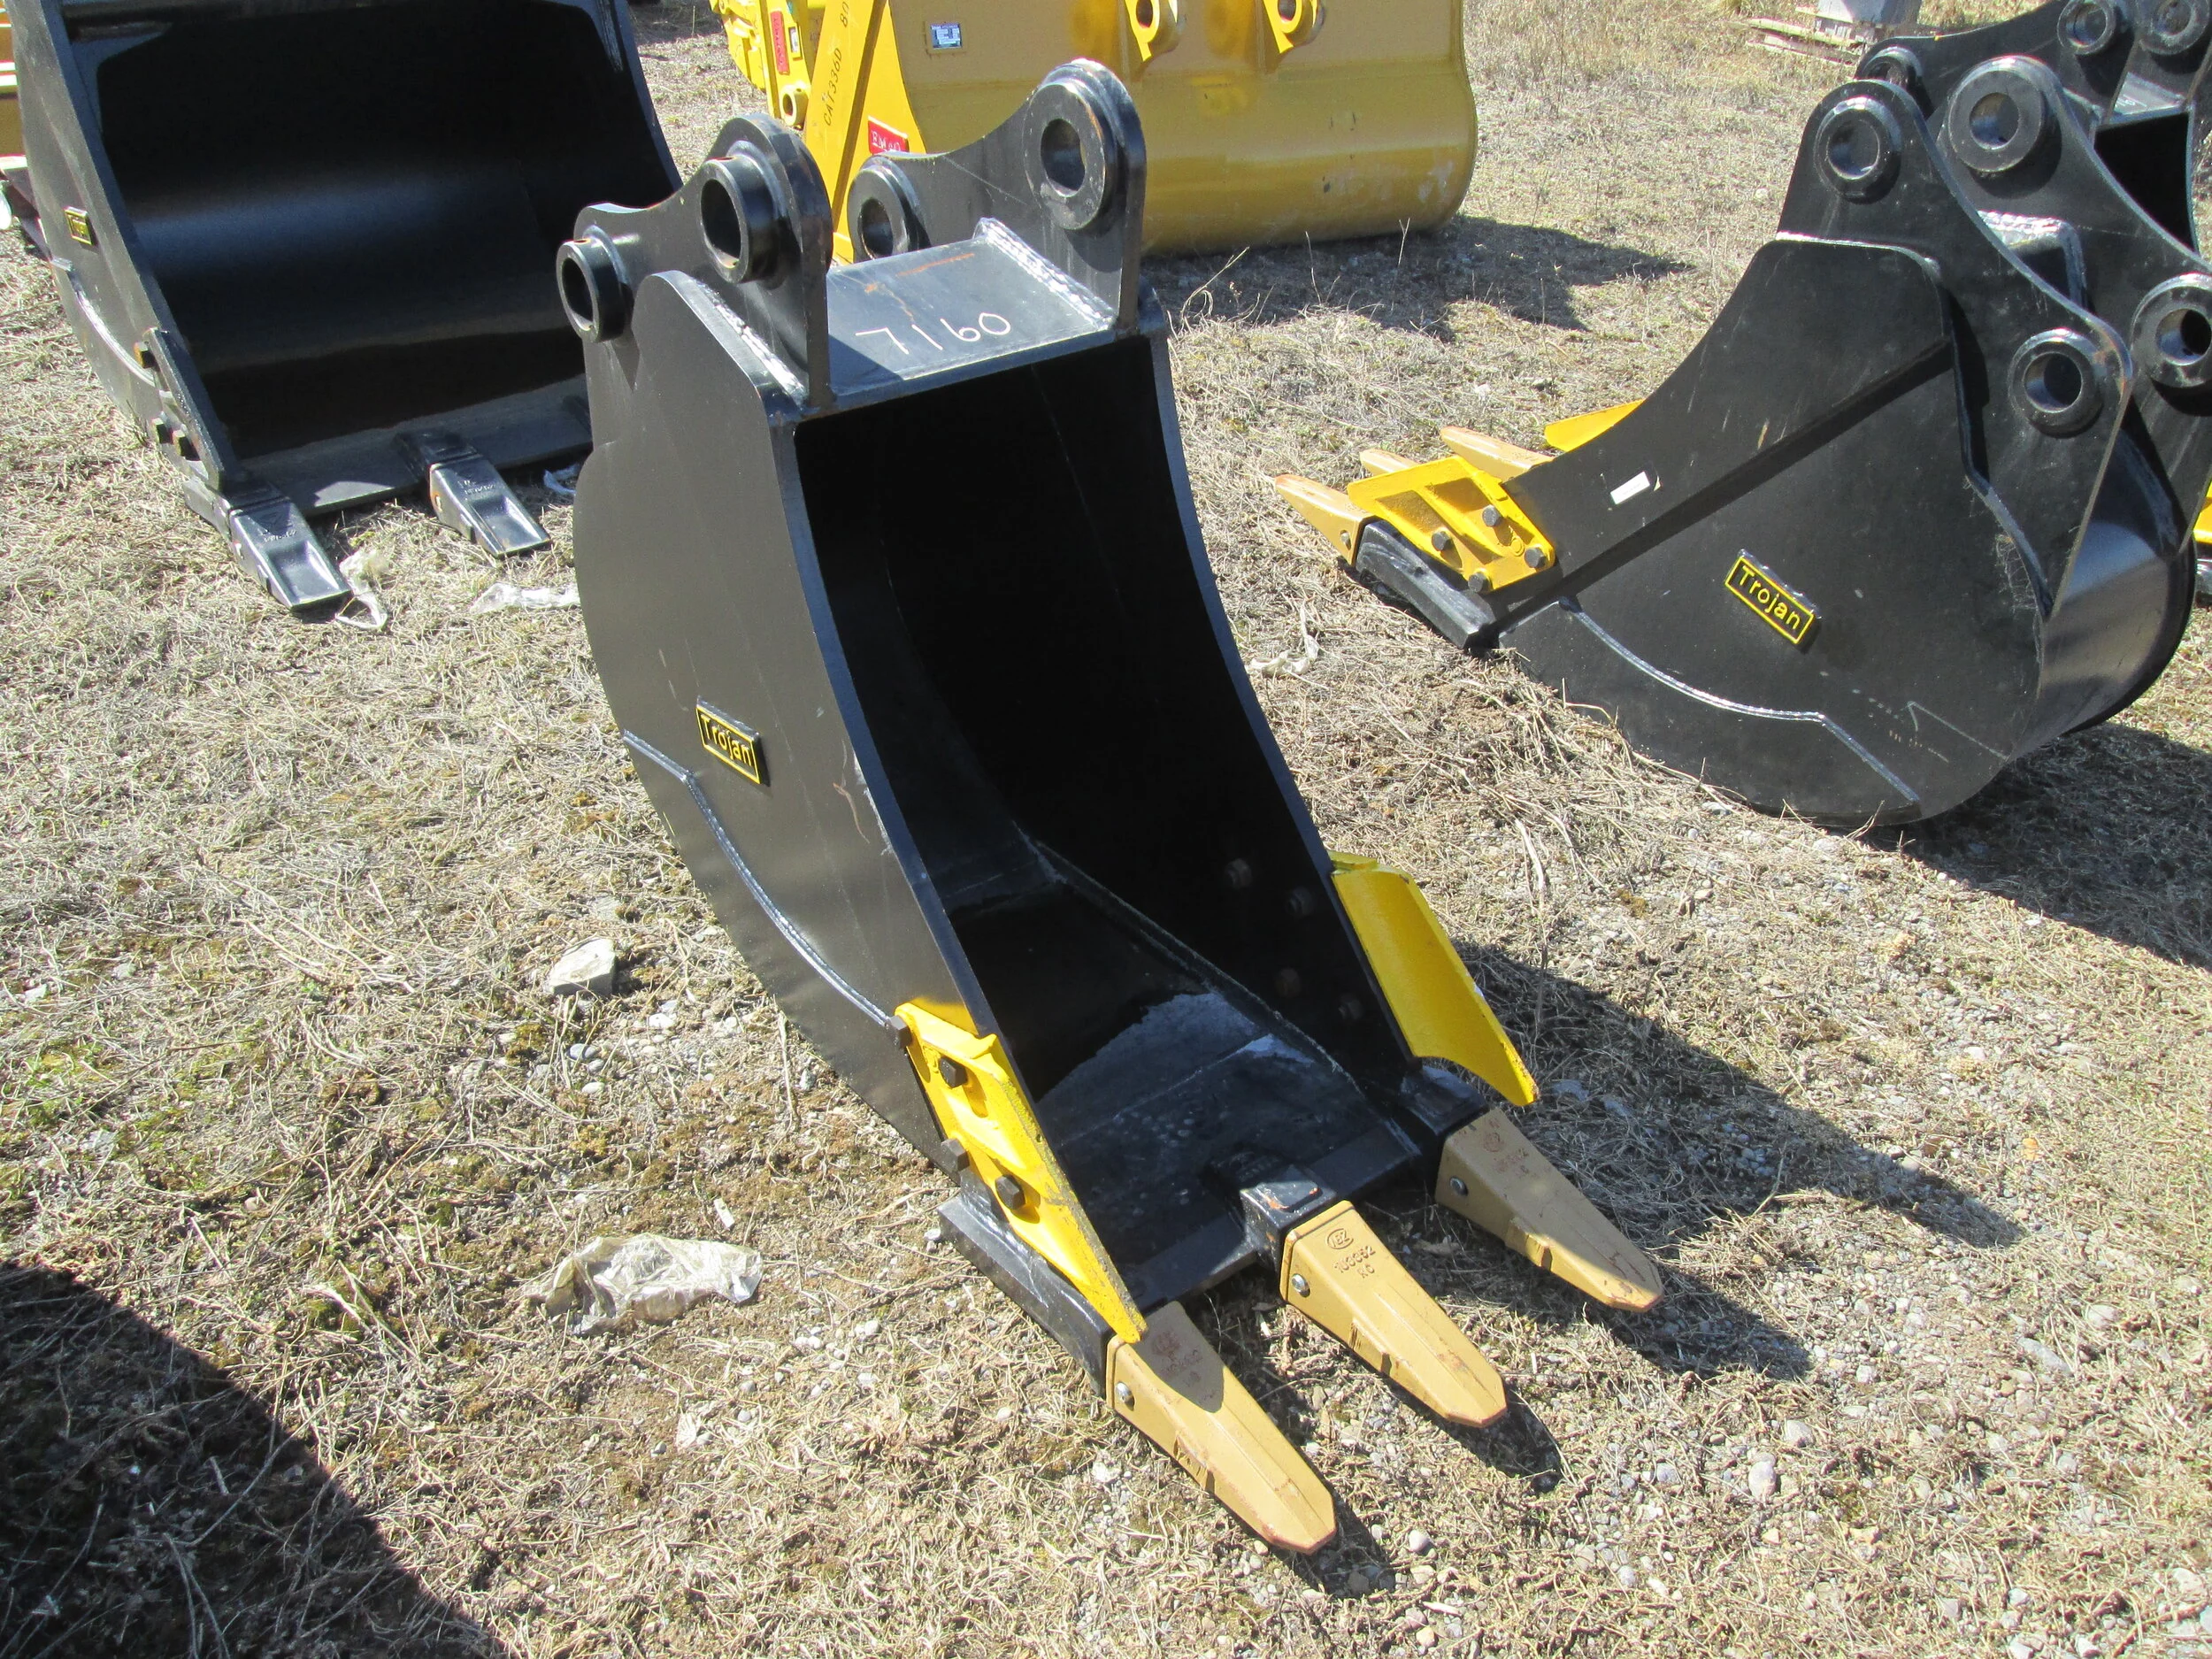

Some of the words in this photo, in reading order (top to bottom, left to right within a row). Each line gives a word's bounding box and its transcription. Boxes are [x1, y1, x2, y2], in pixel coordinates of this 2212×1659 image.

[855, 312, 1011, 355] 7160
[1739, 565, 1801, 630] Trojan
[700, 713, 752, 766] Trojan
